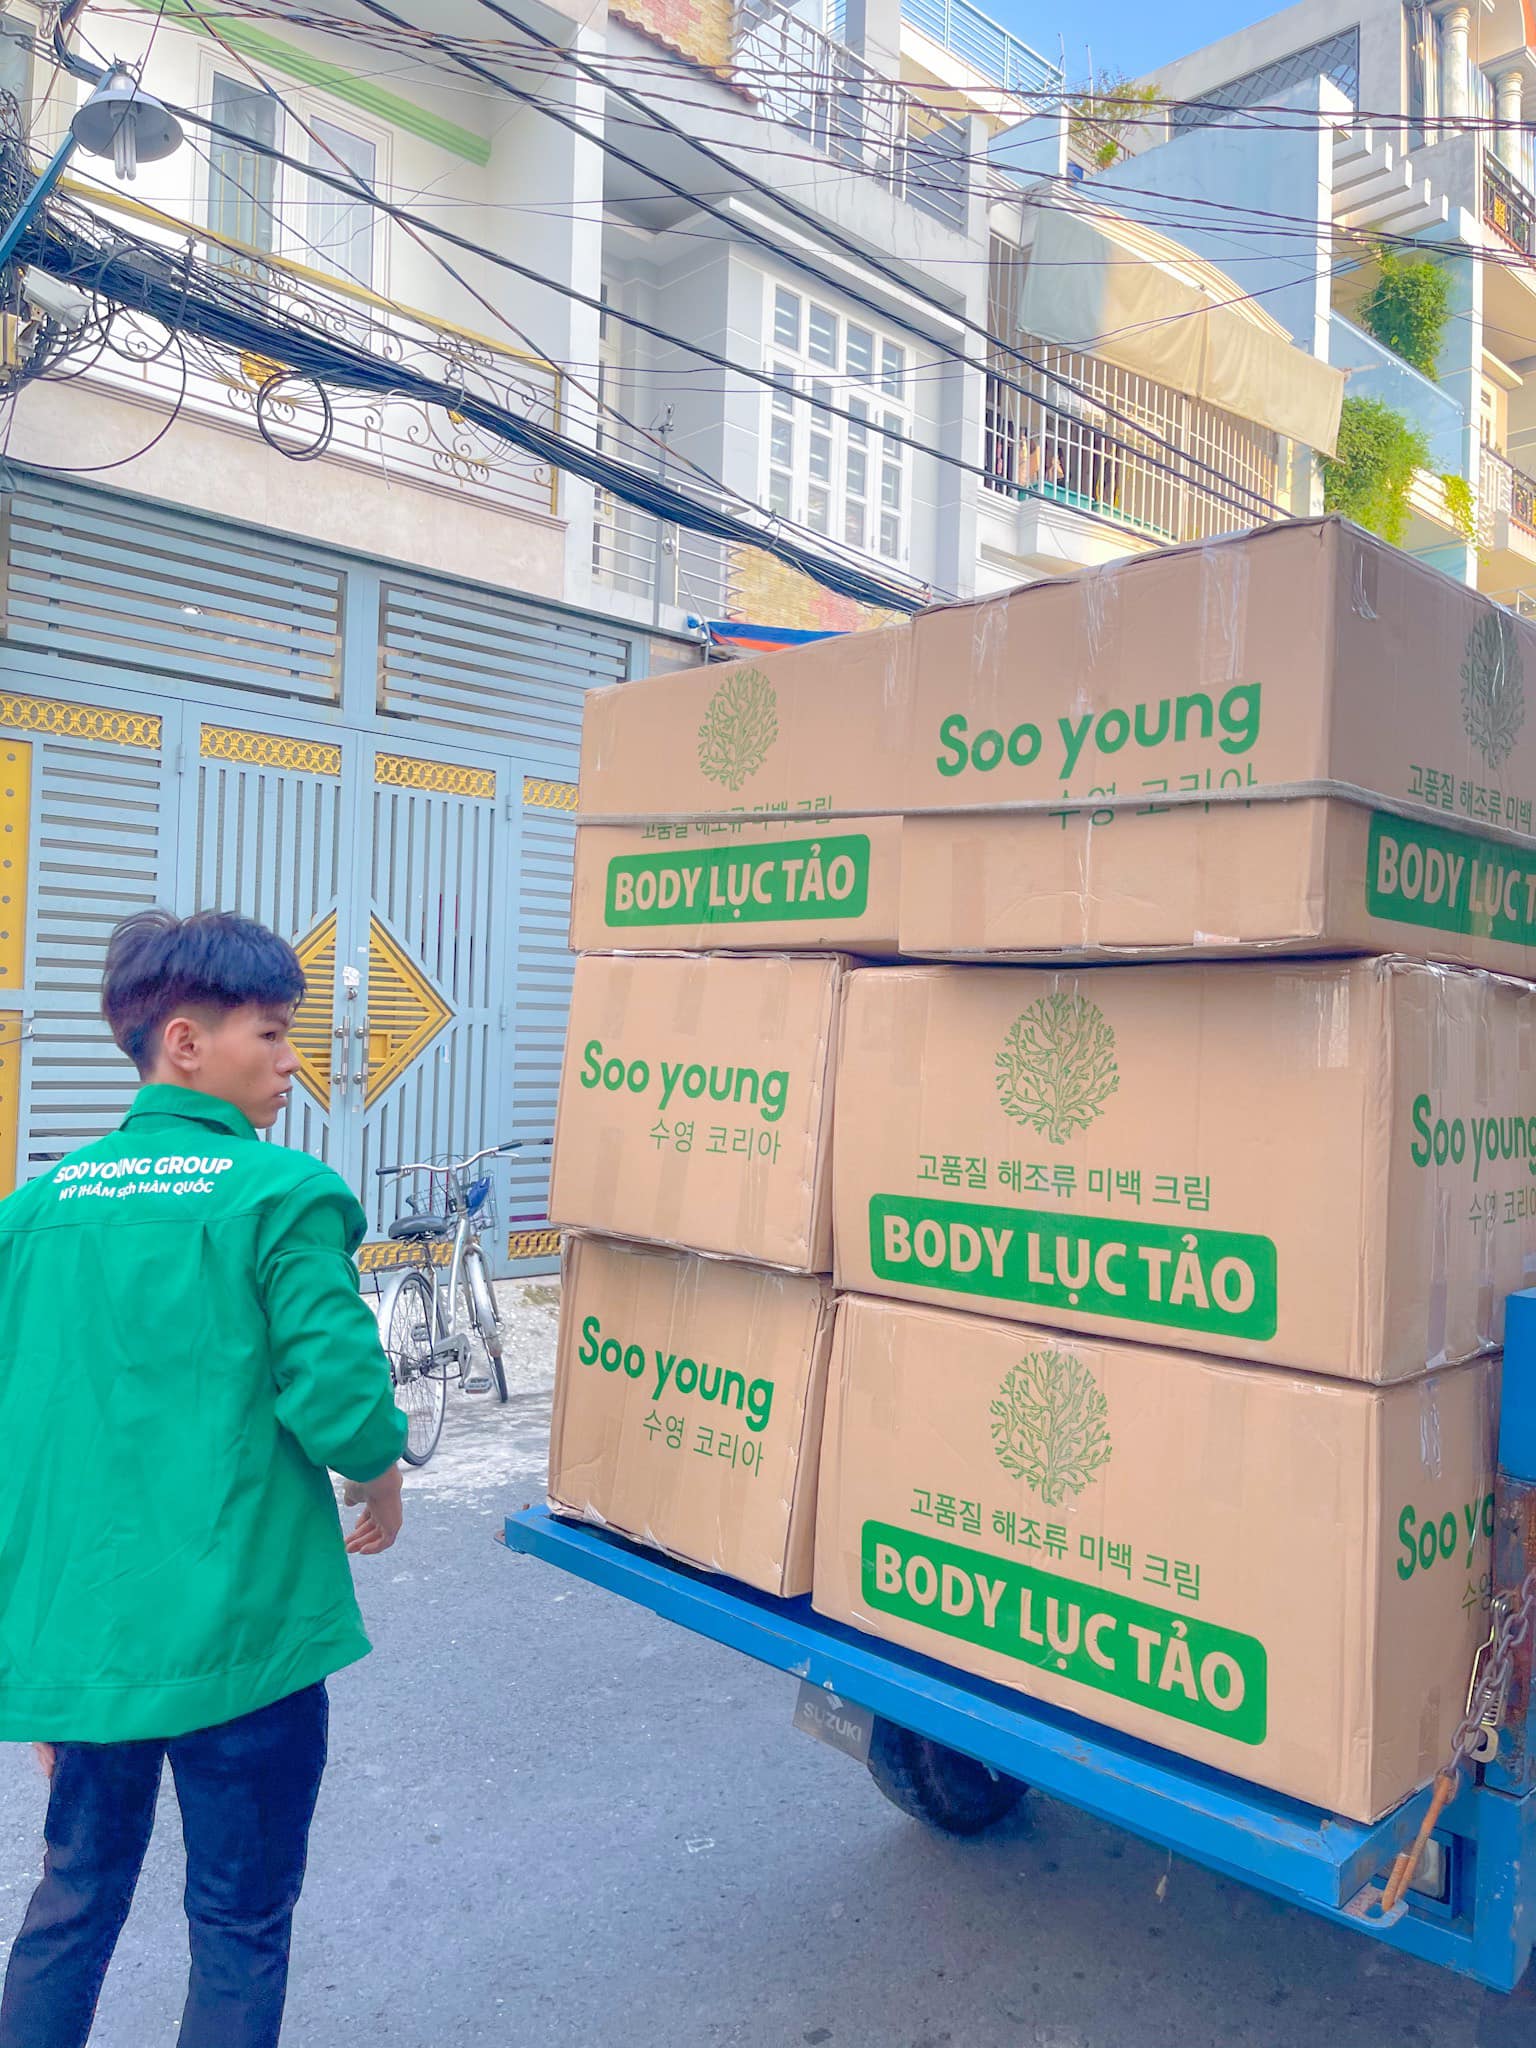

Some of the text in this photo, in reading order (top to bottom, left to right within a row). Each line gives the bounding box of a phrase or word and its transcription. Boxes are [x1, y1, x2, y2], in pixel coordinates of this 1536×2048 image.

[936, 682, 1262, 780] Soo young
[1407, 764, 1455, 810] 고품질
[1460, 781, 1502, 825] 해조류
[614, 843, 856, 918] BODY LỤC TẢO
[1377, 835, 1465, 910] BODY
[580, 1040, 790, 1122] Soo young
[154, 1155, 233, 1176] GROUP
[649, 1117, 782, 1165] 수영 코리아
[1411, 1093, 1466, 1168] Soo
[137, 1179, 171, 1194] HÀN
[172, 1177, 215, 1195] QUỐC
[916, 1153, 1212, 1213] 고품질 해조류 미백 크림
[882, 1214, 1256, 1314] BODY LỤC TẢO
[578, 1316, 774, 1433] Soo young
[642, 1409, 764, 1478] 수영 코리아
[909, 1487, 1201, 1601] 고품질 해조류 미백 크림
[1396, 1504, 1457, 1581] Soo
[875, 1542, 1247, 1713] BODY LỤC TẢO
[802, 1701, 863, 1743] SUZUKI
